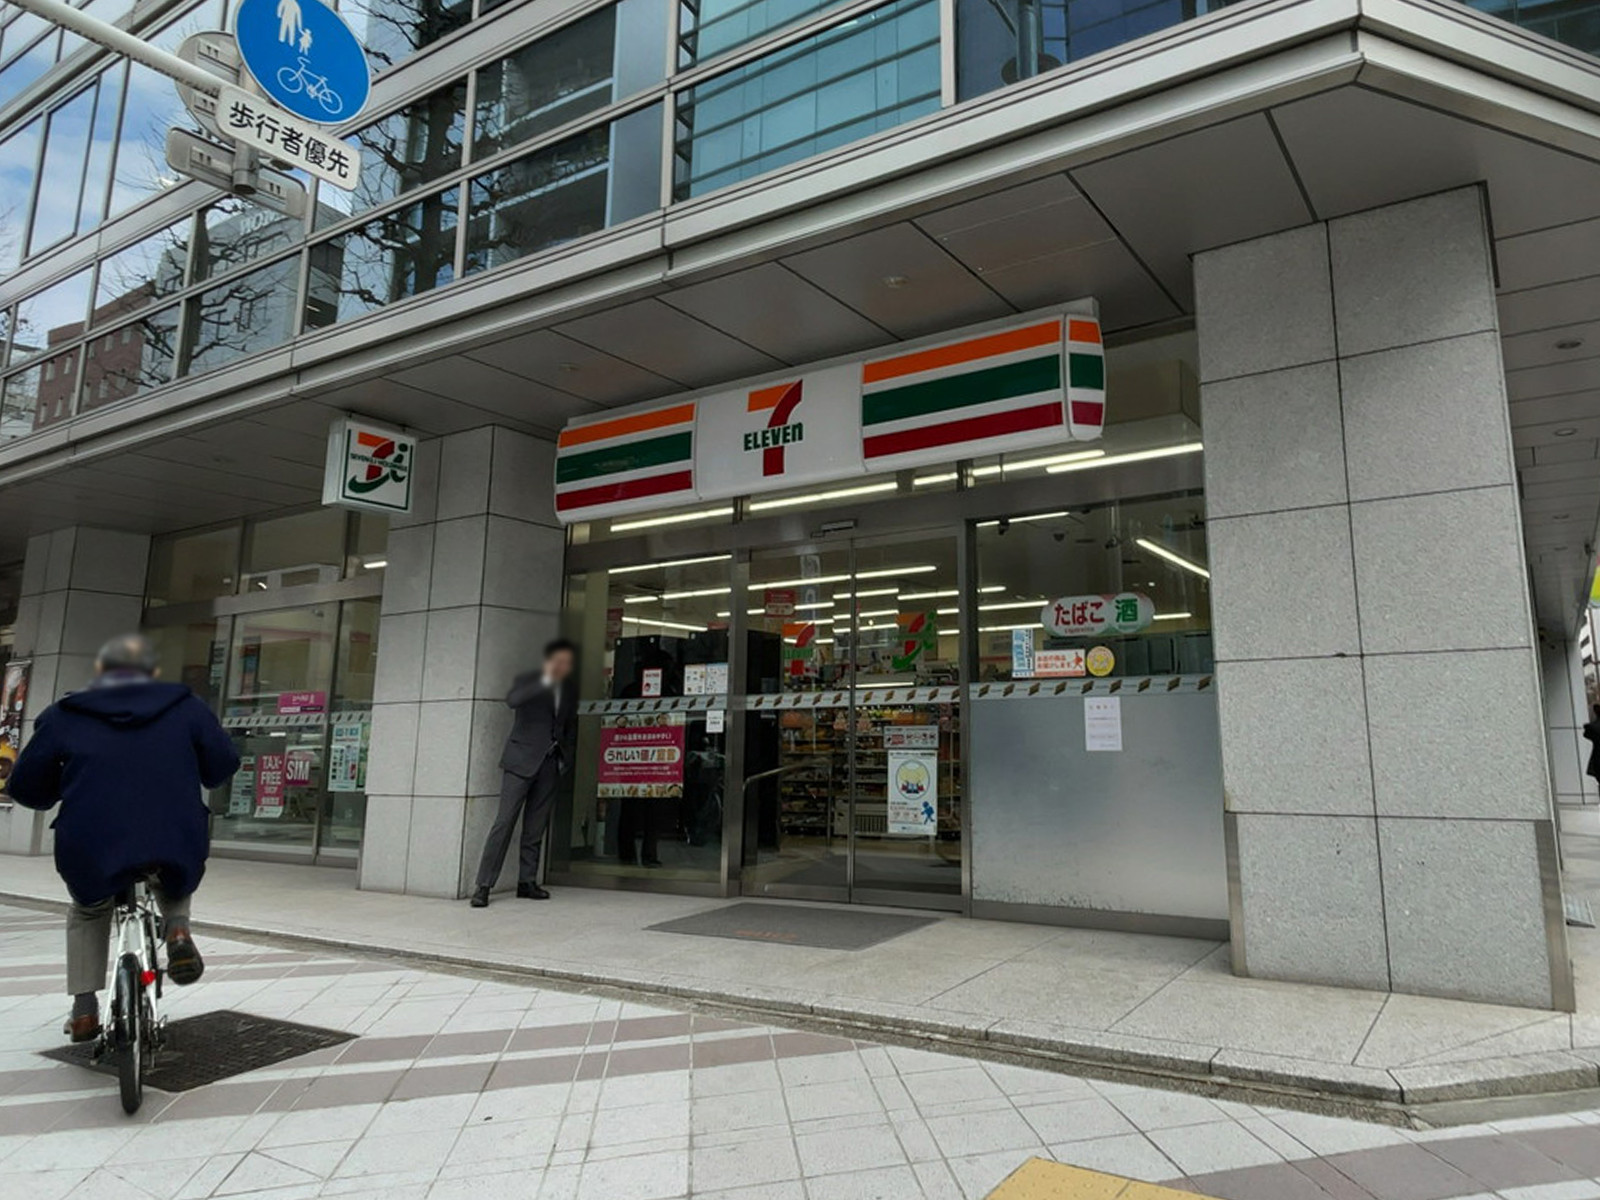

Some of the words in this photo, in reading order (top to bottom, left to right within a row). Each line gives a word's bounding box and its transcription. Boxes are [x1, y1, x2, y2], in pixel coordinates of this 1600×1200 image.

[229, 101, 350, 179] 歩行者優先
[747, 378, 803, 476] 7
[1054, 601, 1105, 626] たばこ
[1115, 598, 1139, 623] 酒
[260, 772, 282, 785] FREE
[286, 761, 310, 781] SIM
